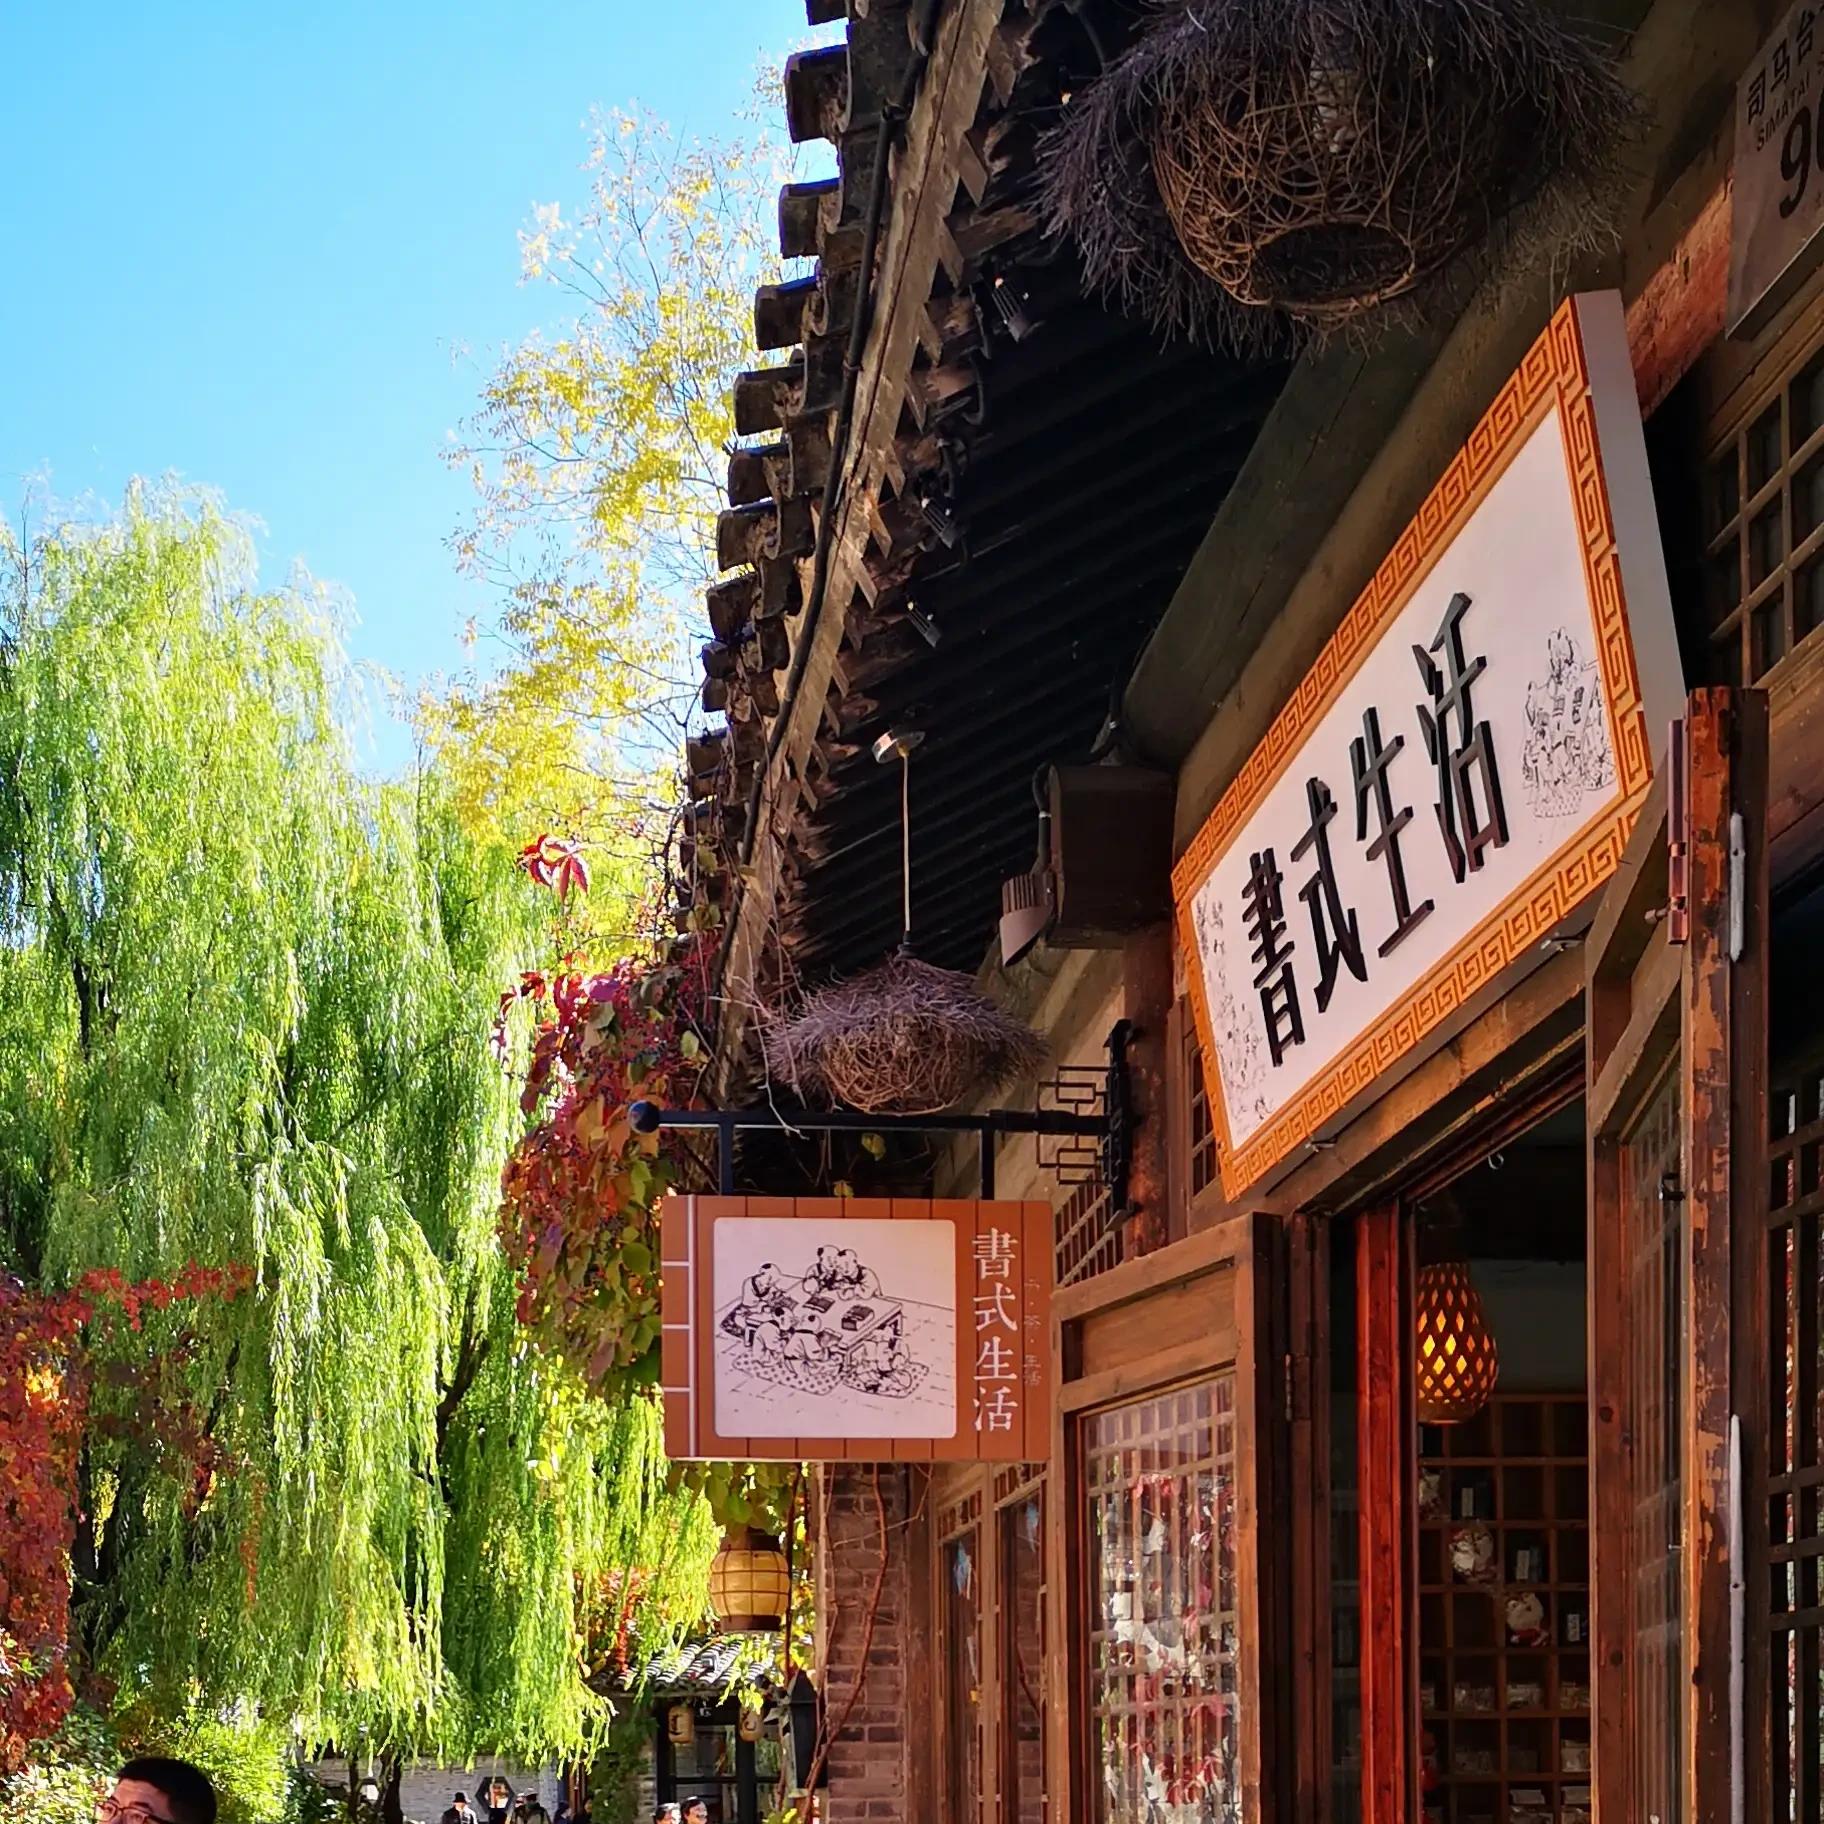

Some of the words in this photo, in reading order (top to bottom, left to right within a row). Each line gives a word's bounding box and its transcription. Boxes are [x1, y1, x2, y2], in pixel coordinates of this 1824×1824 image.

[1747, 3, 1824, 125] 司马台
[1756, 69, 1810, 152] SIMATAI
[1239, 592, 1511, 1068] 書式生活
[972, 1227, 1019, 1432] 書式生活
